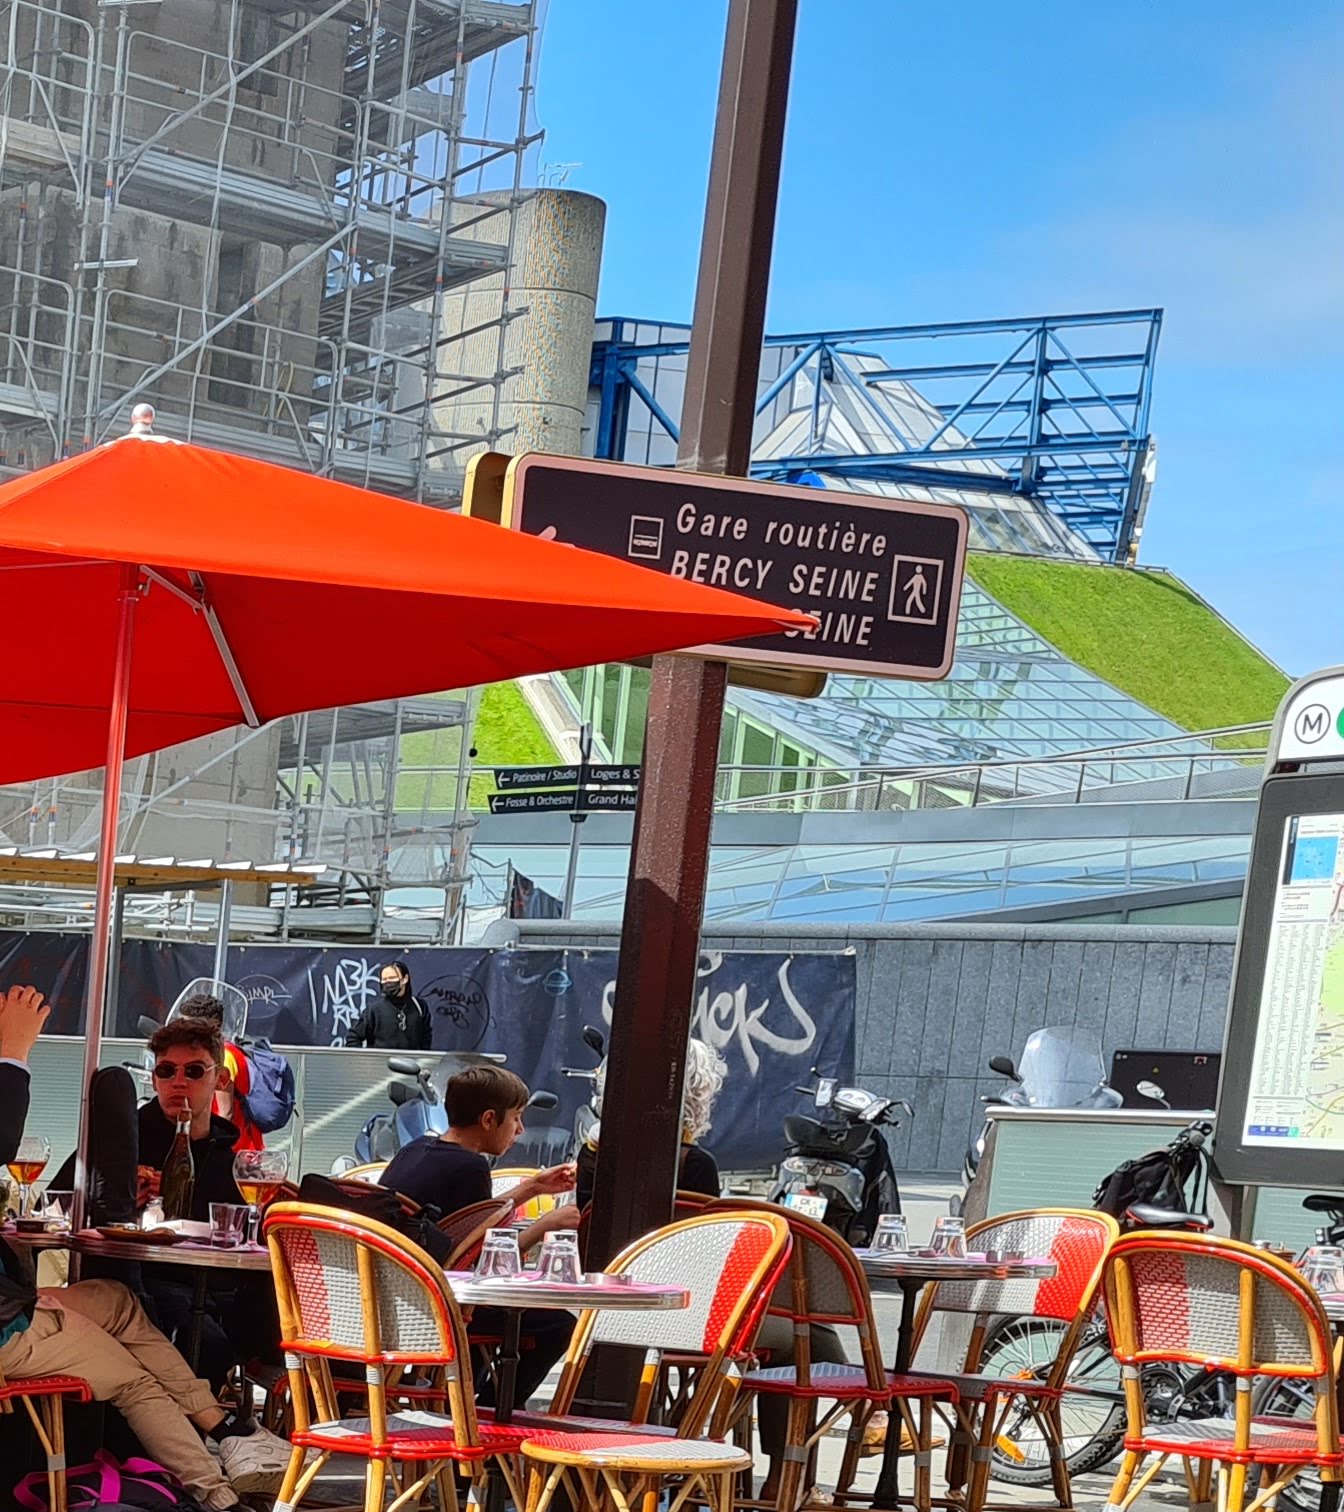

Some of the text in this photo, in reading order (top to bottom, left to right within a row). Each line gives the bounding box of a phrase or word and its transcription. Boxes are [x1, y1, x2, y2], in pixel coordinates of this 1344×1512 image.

[676, 502, 888, 558] Gare routière
[670, 549, 880, 603] BERCY SEINE
[553, 768, 578, 780] Studio
[590, 768, 621, 781] Loges
[506, 797, 528, 807] Fosse
[536, 794, 574, 806] Orchestre
[587, 793, 618, 804] Grand
